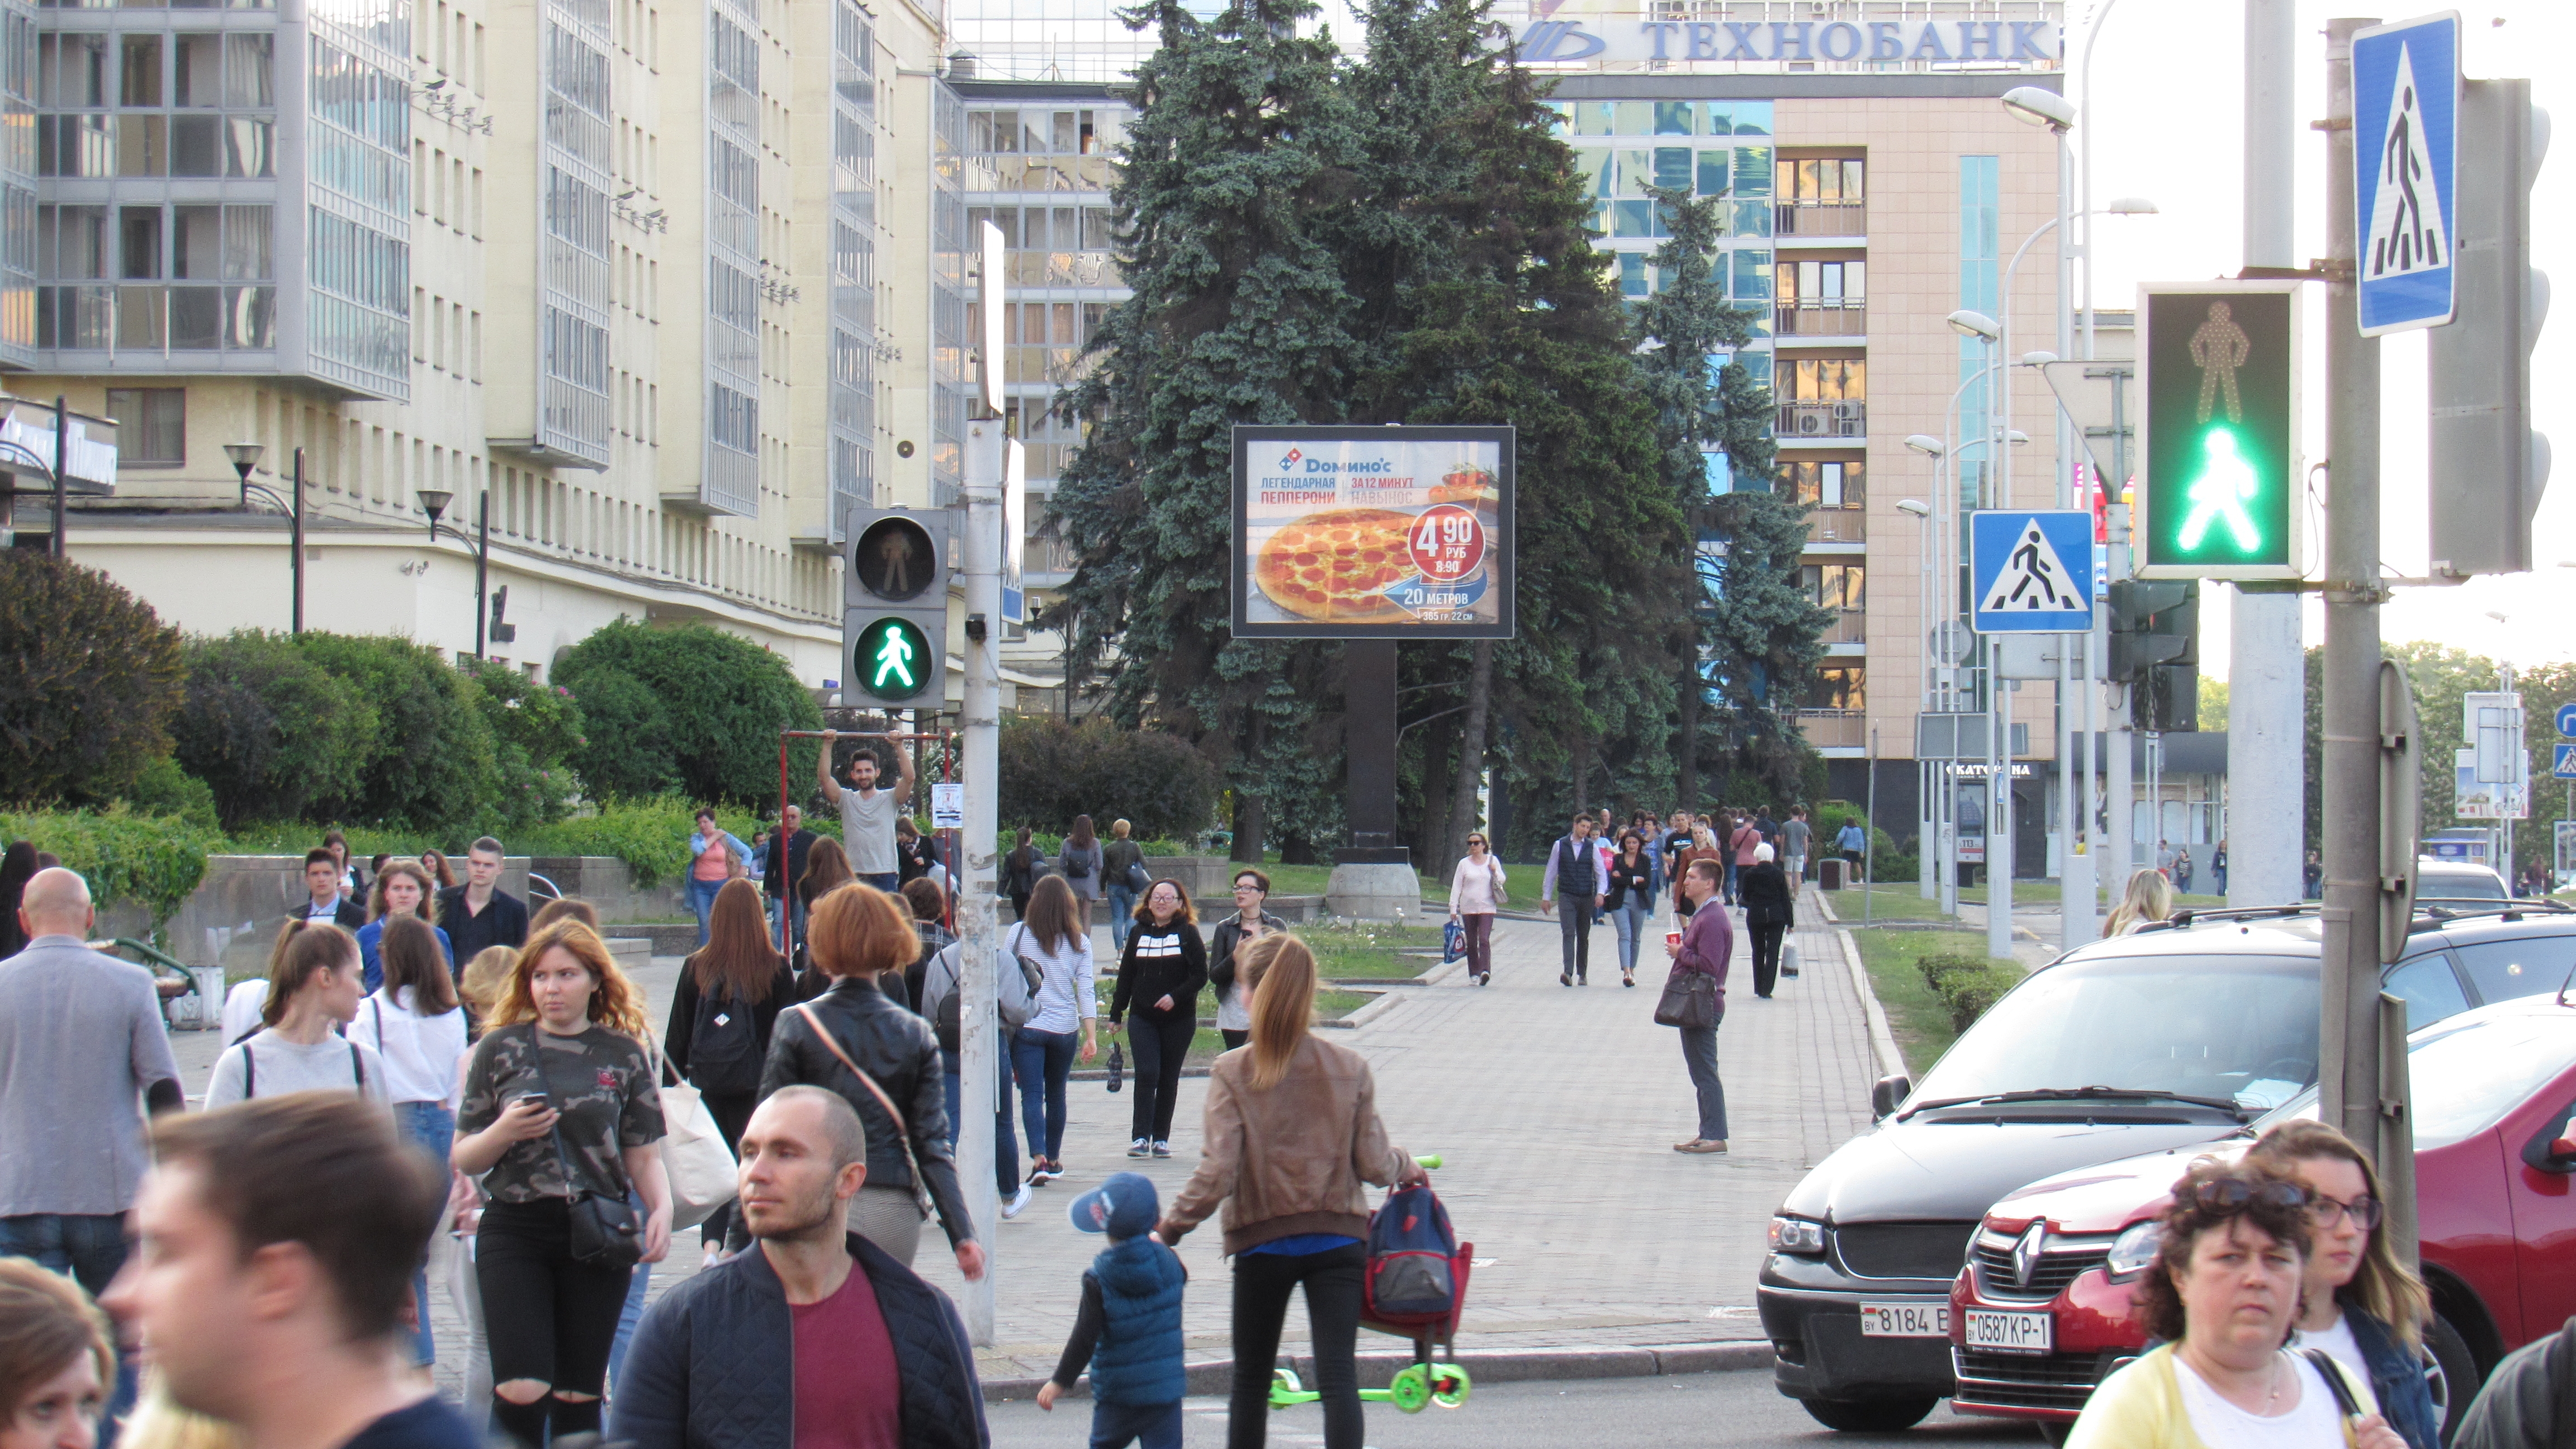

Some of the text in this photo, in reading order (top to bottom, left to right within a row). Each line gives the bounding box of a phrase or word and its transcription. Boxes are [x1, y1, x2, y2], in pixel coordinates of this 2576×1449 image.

[1641, 21, 2052, 60] ТЕХНОБАНК
[1261, 477, 1336, 489] ЛЕГЕНДАРНАЯ
[1379, 477, 1414, 488] МИНУТ
[1261, 491, 1336, 504] ПЕППЕРОНИ
[1416, 516, 1472, 557] 4 90
[1446, 547, 1466, 558] РУБ
[1404, 588, 1469, 605] 20 МЕТРОВ
[1451, 612, 1461, 621] 22
[1864, 1321, 1874, 1330] BY
[1881, 1308, 1928, 1332] 8184
[1977, 1314, 2007, 1342] 0587
[2010, 1316, 2046, 1344] KP-1
